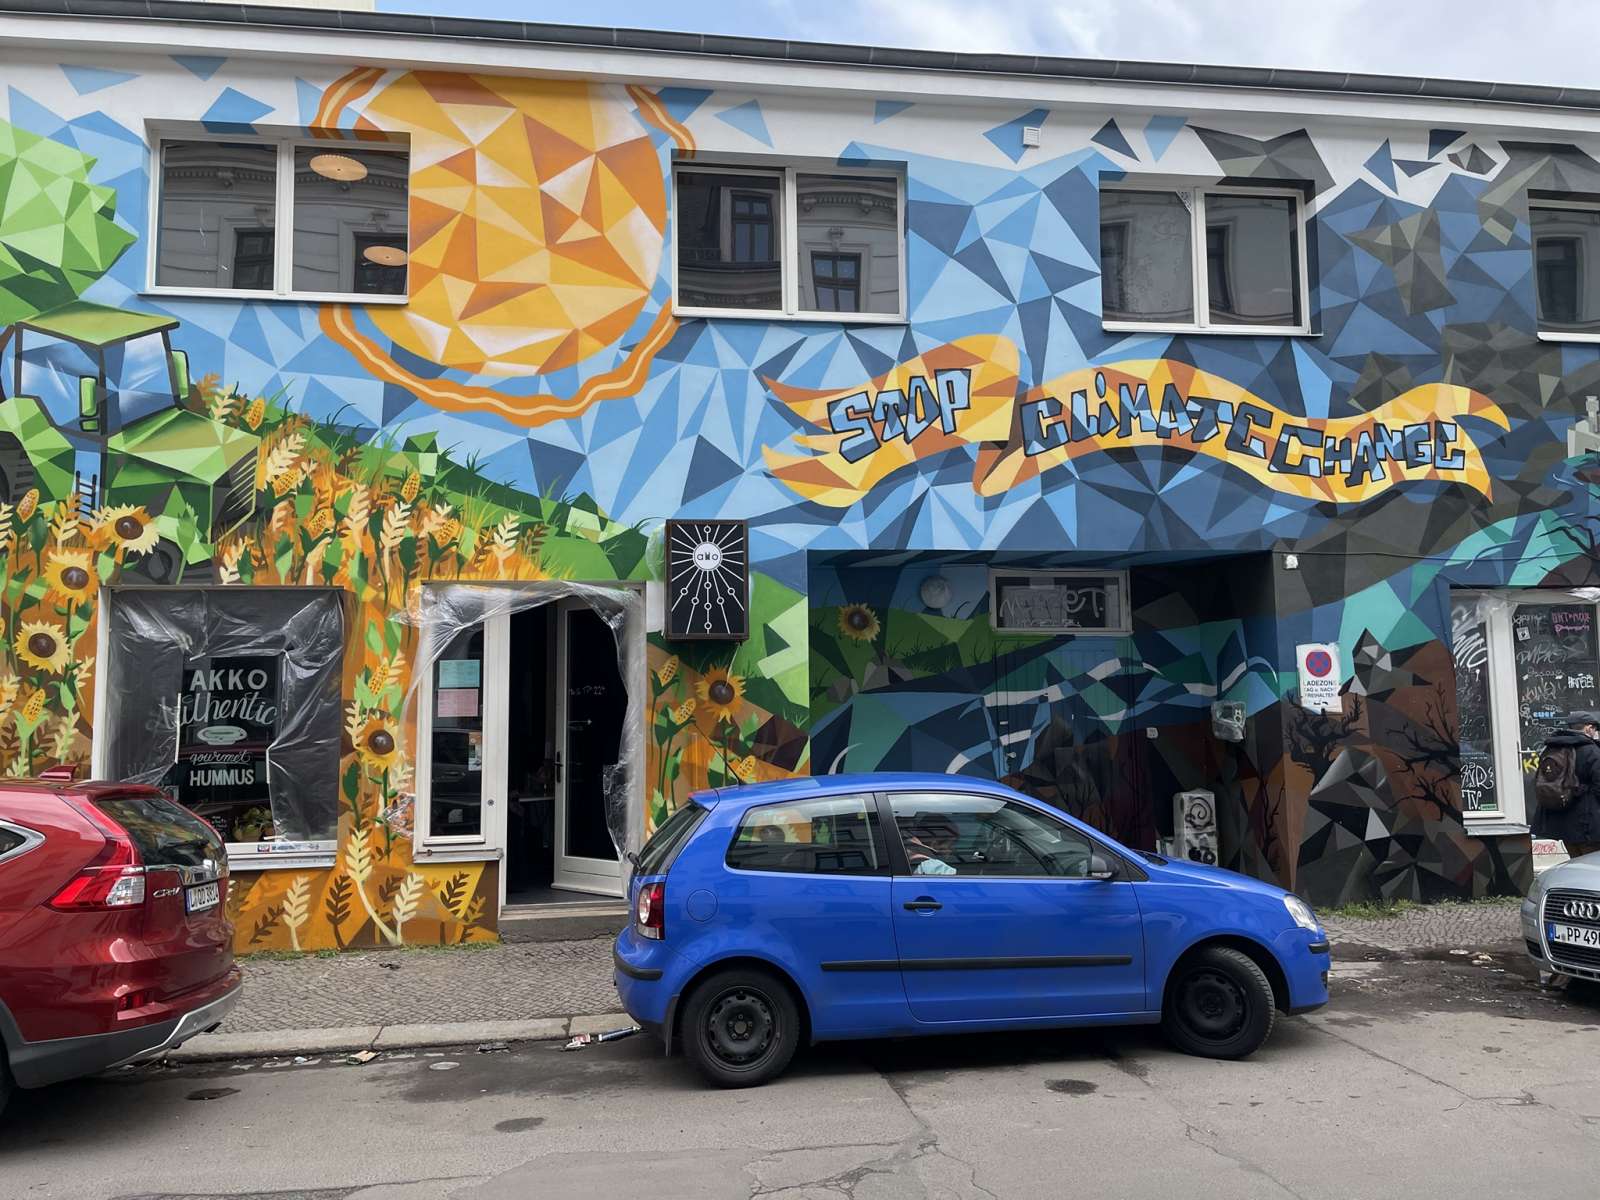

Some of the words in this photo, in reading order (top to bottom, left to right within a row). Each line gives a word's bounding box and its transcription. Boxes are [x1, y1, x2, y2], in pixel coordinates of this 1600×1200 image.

[827, 368, 971, 464] STOP
[1268, 420, 1465, 488] CHANGE
[190, 668, 268, 691] AKKO
[190, 750, 251, 766] gourmet
[190, 768, 255, 787] HUMMUS
[1567, 927, 1581, 942] PP
[1583, 929, 1600, 946] 49
